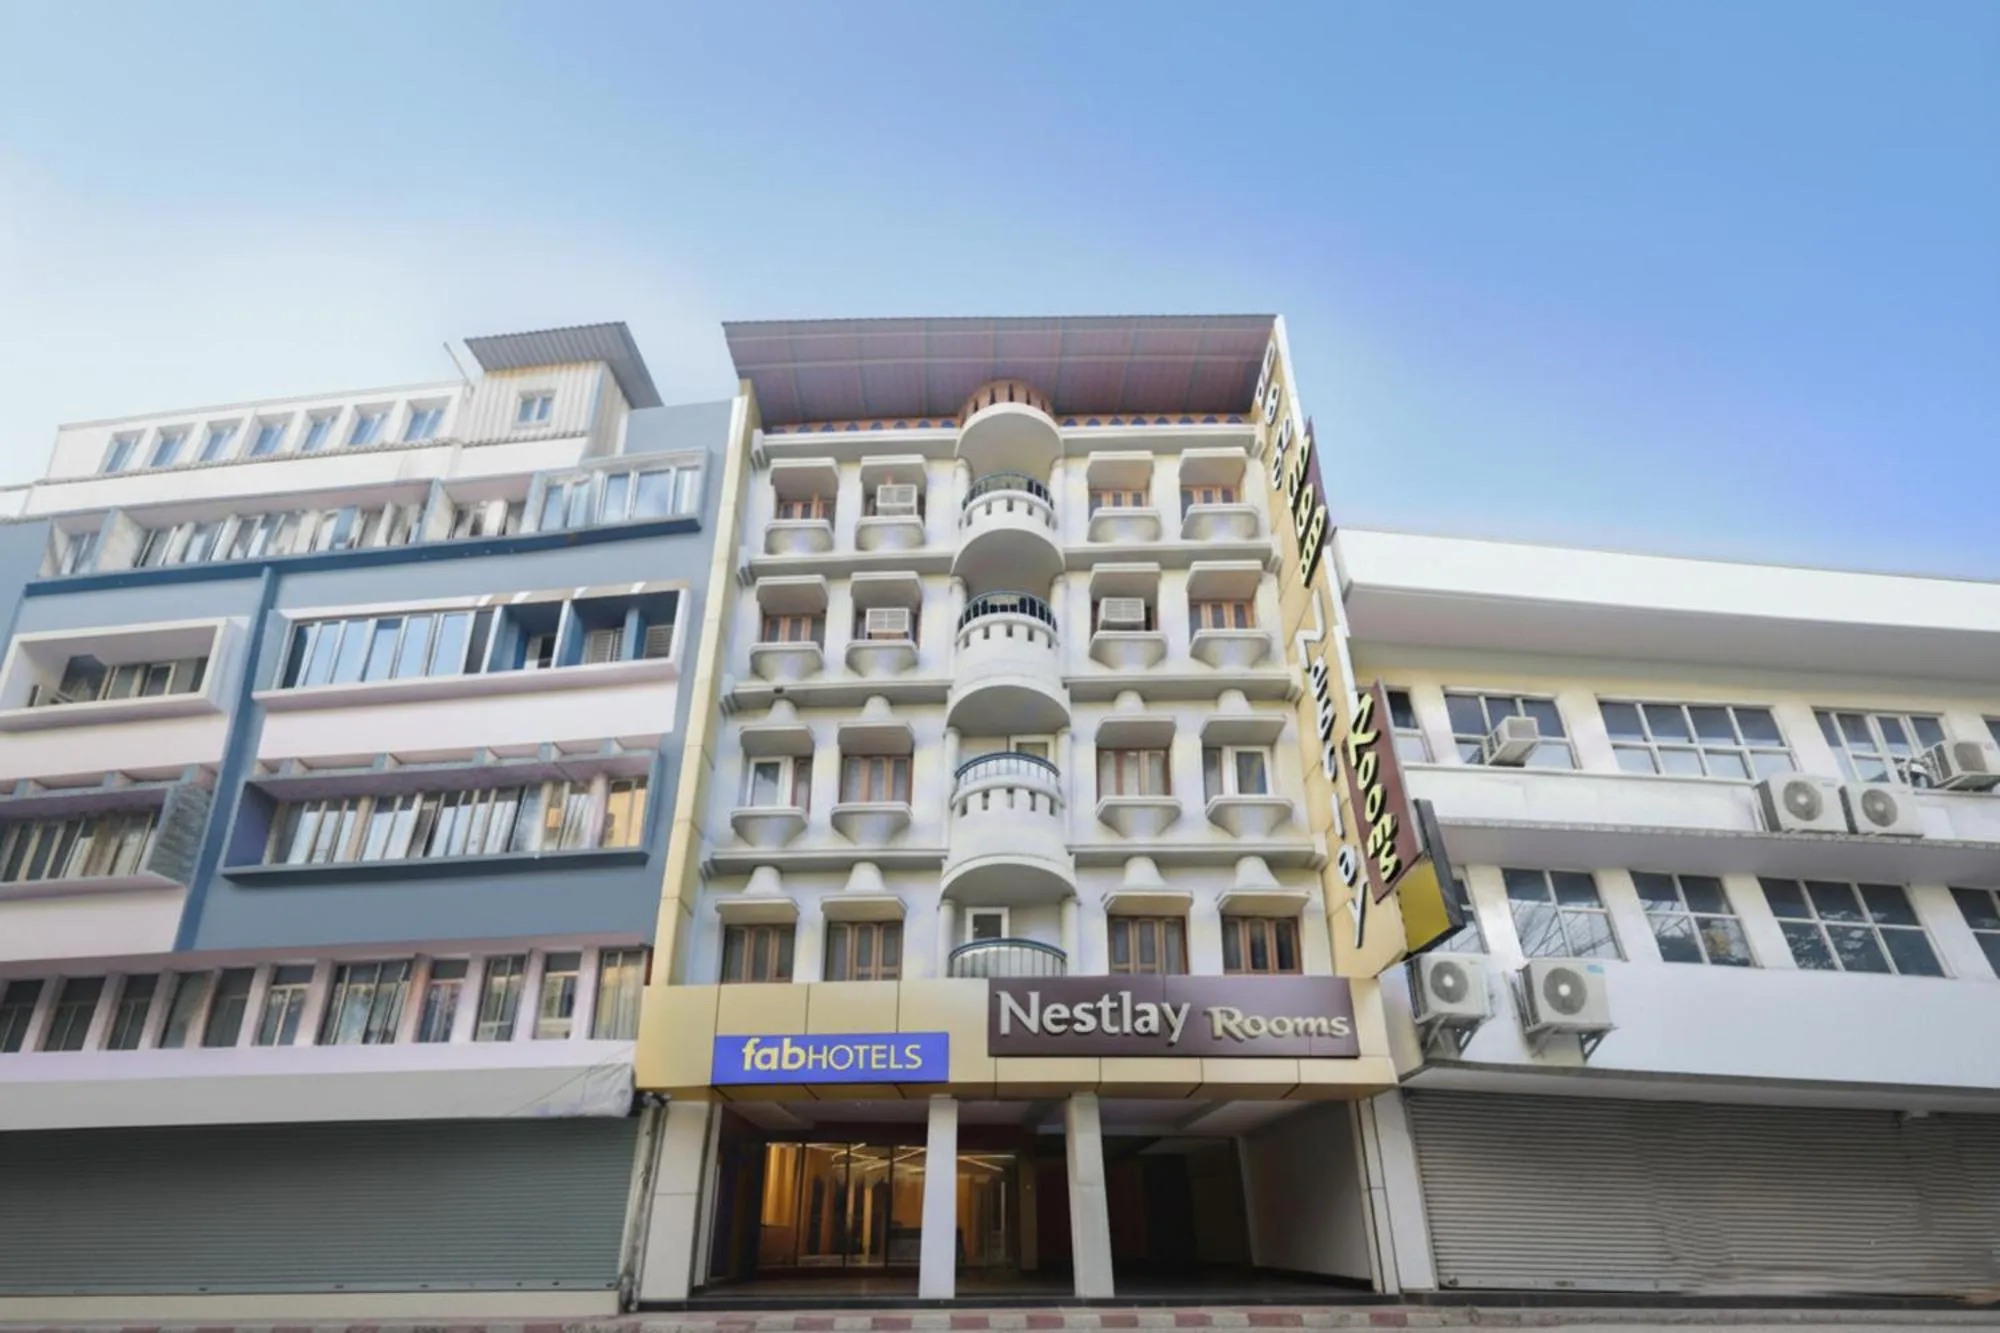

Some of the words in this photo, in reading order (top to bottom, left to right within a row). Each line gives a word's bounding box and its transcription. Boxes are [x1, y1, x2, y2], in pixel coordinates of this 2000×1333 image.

[996, 990, 1191, 1044] Nestlay
[1204, 1006, 1352, 1041] Rooms
[741, 1037, 923, 1070] fabHOTELS
